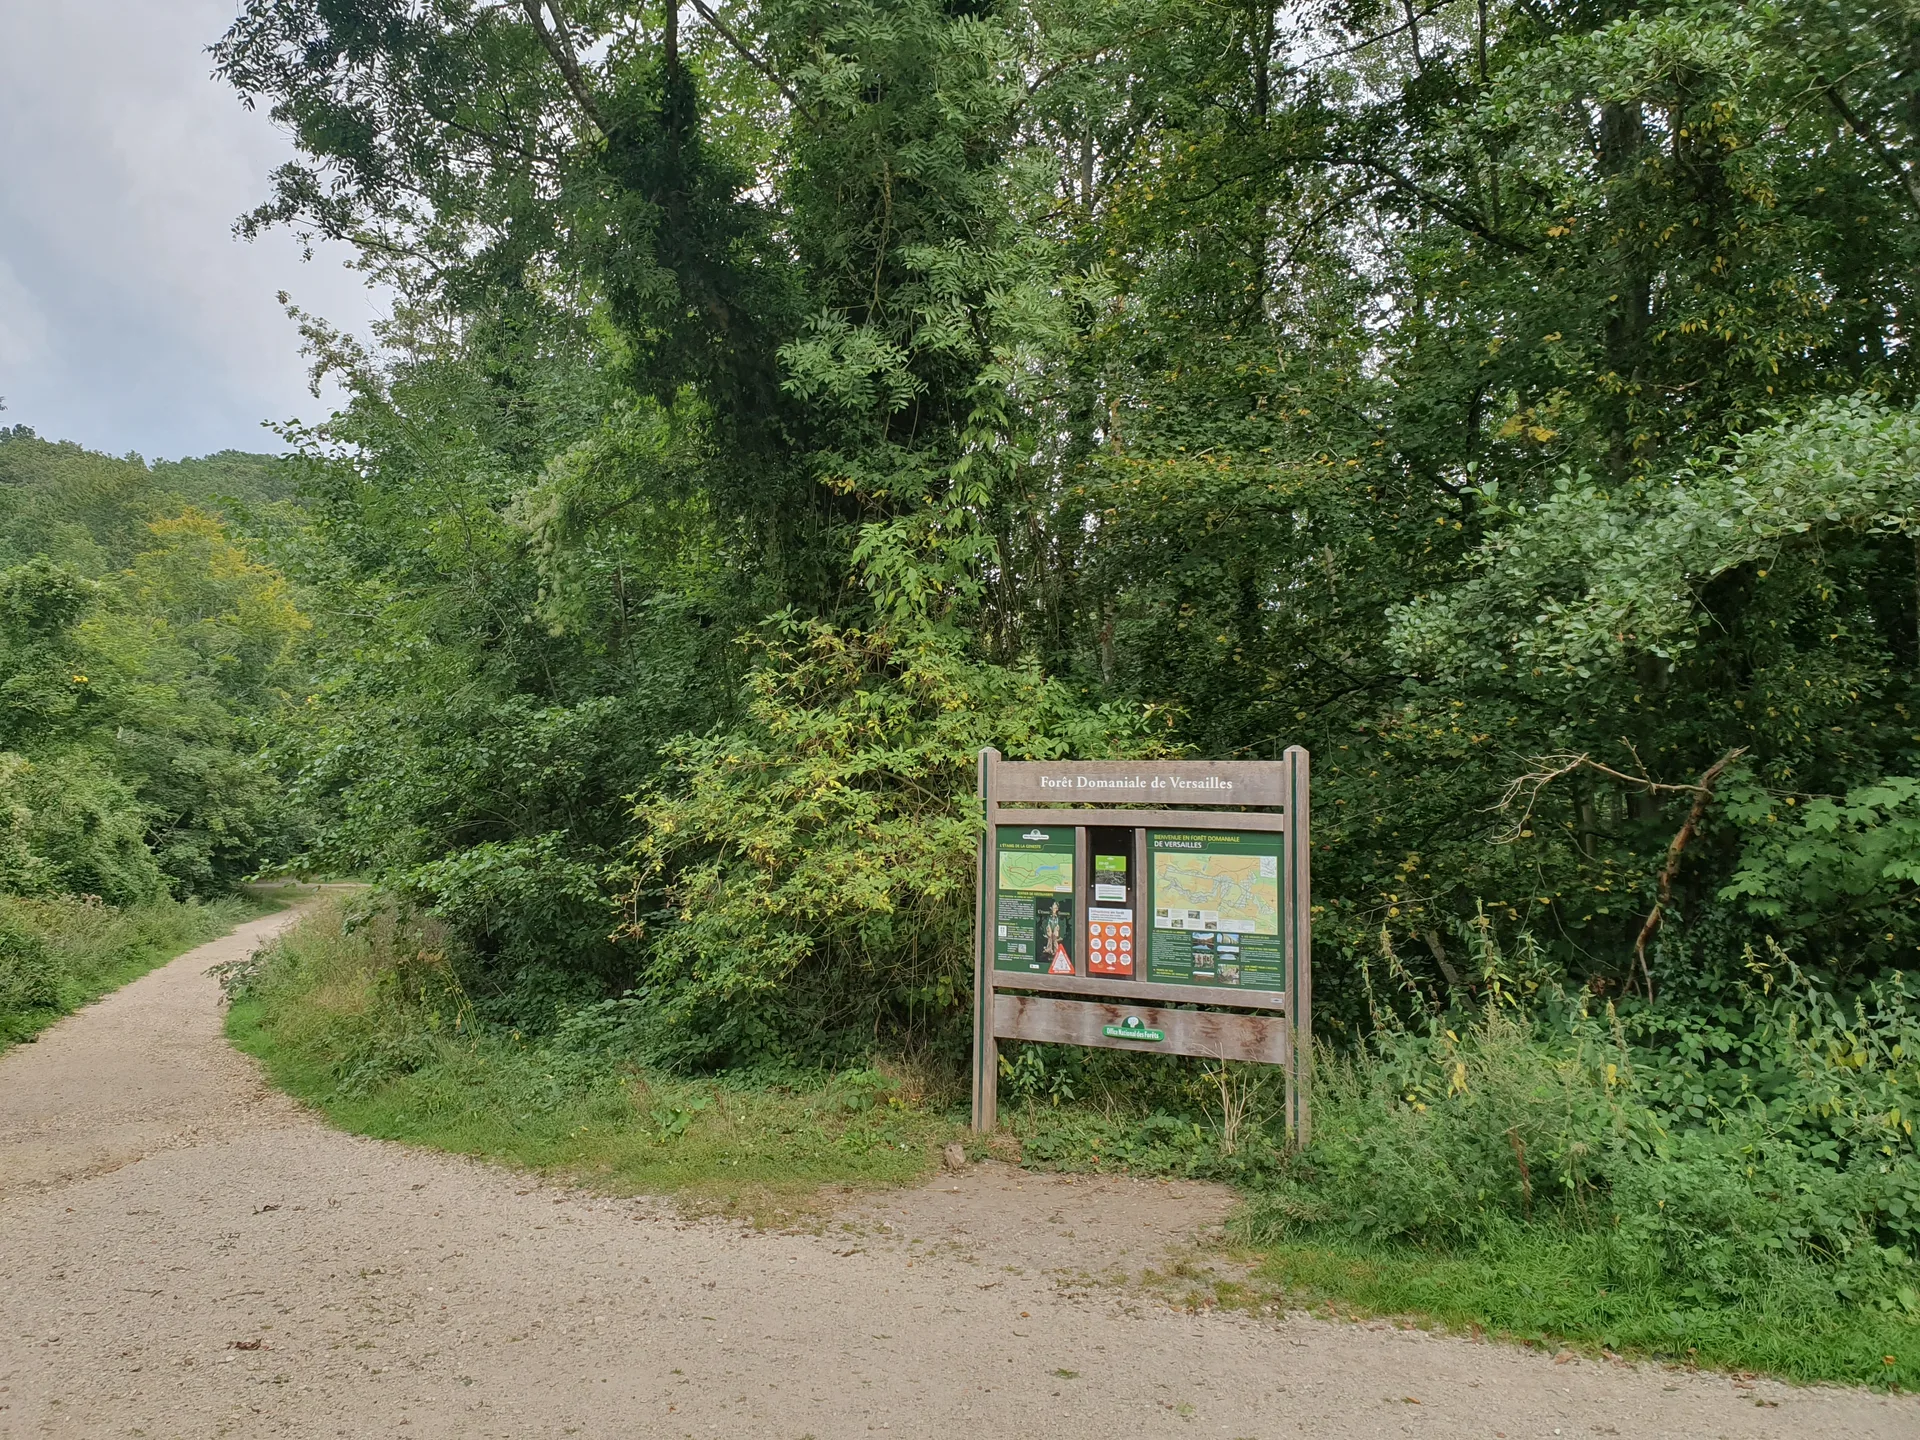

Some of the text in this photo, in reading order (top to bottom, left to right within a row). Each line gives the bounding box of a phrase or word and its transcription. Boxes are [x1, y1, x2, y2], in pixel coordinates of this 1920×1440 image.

[1040, 775, 1233, 789] Forêt Domaniale de Versailles
[1190, 834, 1207, 842] FORÊT
[1207, 835, 1240, 843] DOMANIALE
[1164, 841, 1202, 849] VERSAILLES
[1106, 1027, 1159, 1039] Office National des Forêts
